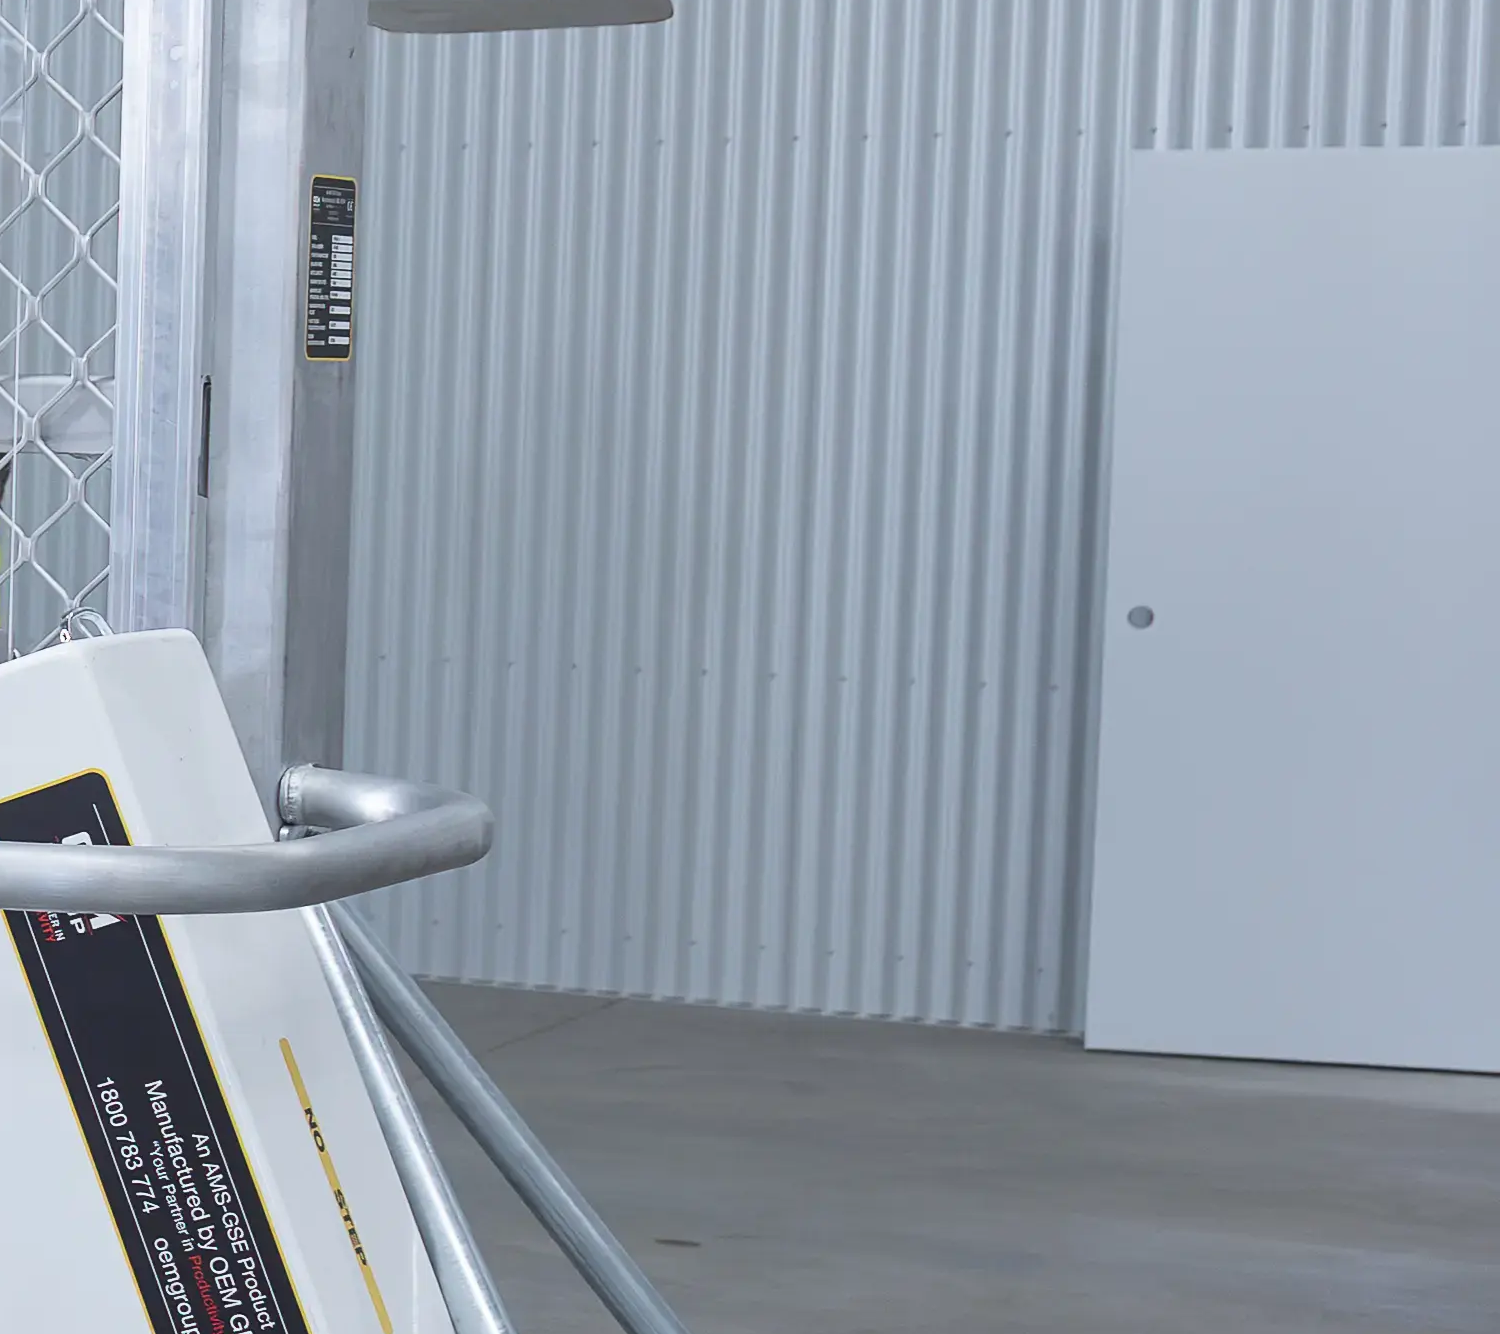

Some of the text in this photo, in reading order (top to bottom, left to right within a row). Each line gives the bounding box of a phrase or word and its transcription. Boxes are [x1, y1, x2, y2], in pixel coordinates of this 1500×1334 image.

[97, 1076, 128, 1127] 1800
[116, 1131, 143, 1171] 783
[132, 1174, 160, 1214] 774
[145, 1079, 211, 1222] Manufactured
[197, 1225, 218, 1251] by
[210, 1256, 243, 1309] OEM
[304, 1107, 325, 1152] NO
[161, 1183, 189, 1236] Partner
[182, 1238, 195, 1252] in
[191, 1133, 276, 1330] An AMS-GSE Product
